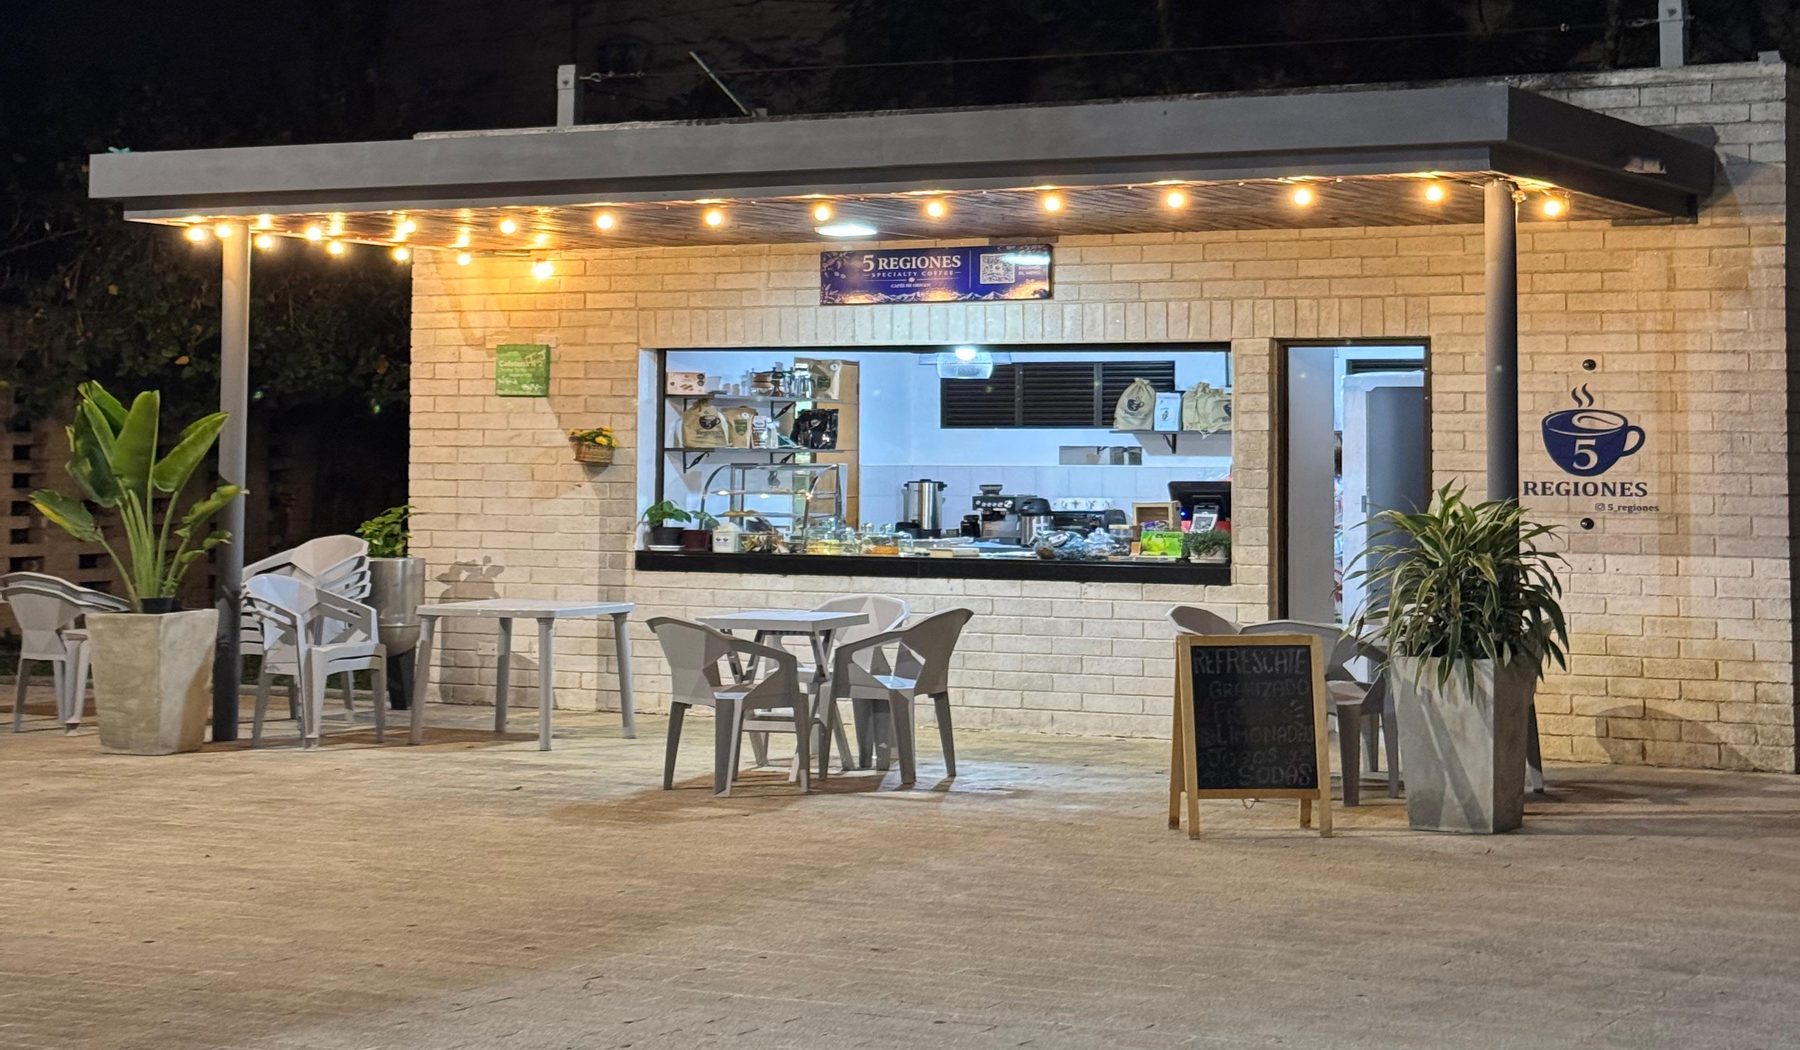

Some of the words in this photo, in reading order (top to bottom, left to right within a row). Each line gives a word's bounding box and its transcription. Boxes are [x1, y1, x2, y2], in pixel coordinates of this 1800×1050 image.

[863, 254, 875, 272] 5
[878, 254, 961, 270] REGIONES
[1572, 439, 1598, 470] 5
[1523, 481, 1648, 497] REGIONES
[1607, 503, 1660, 514] 5_regiones
